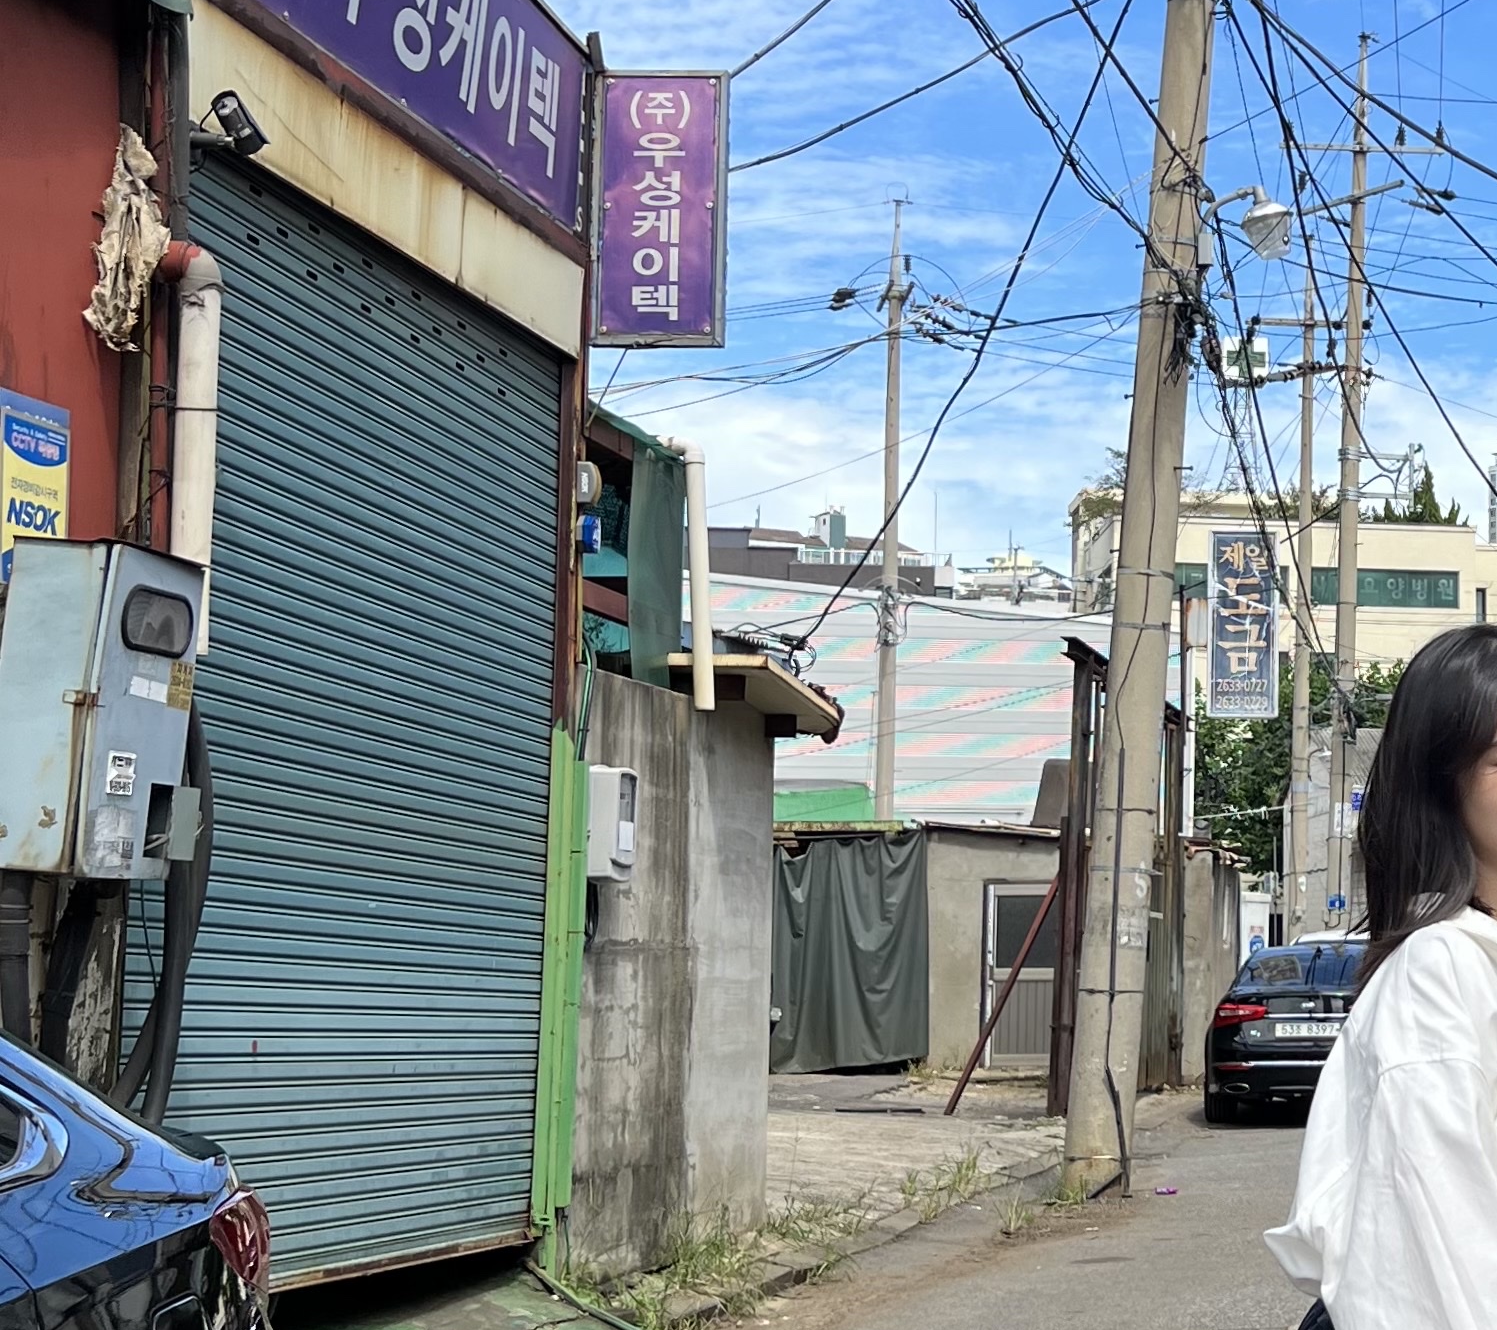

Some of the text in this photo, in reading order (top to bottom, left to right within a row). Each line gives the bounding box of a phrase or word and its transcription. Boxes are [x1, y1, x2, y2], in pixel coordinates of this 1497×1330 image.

[11, 431, 36, 453] CCTV
[7, 497, 61, 536] NSOK
[1219, 541, 1269, 571] 제일
[1216, 577, 1267, 674] 도금
[1216, 678, 1268, 692] 2633-0727
